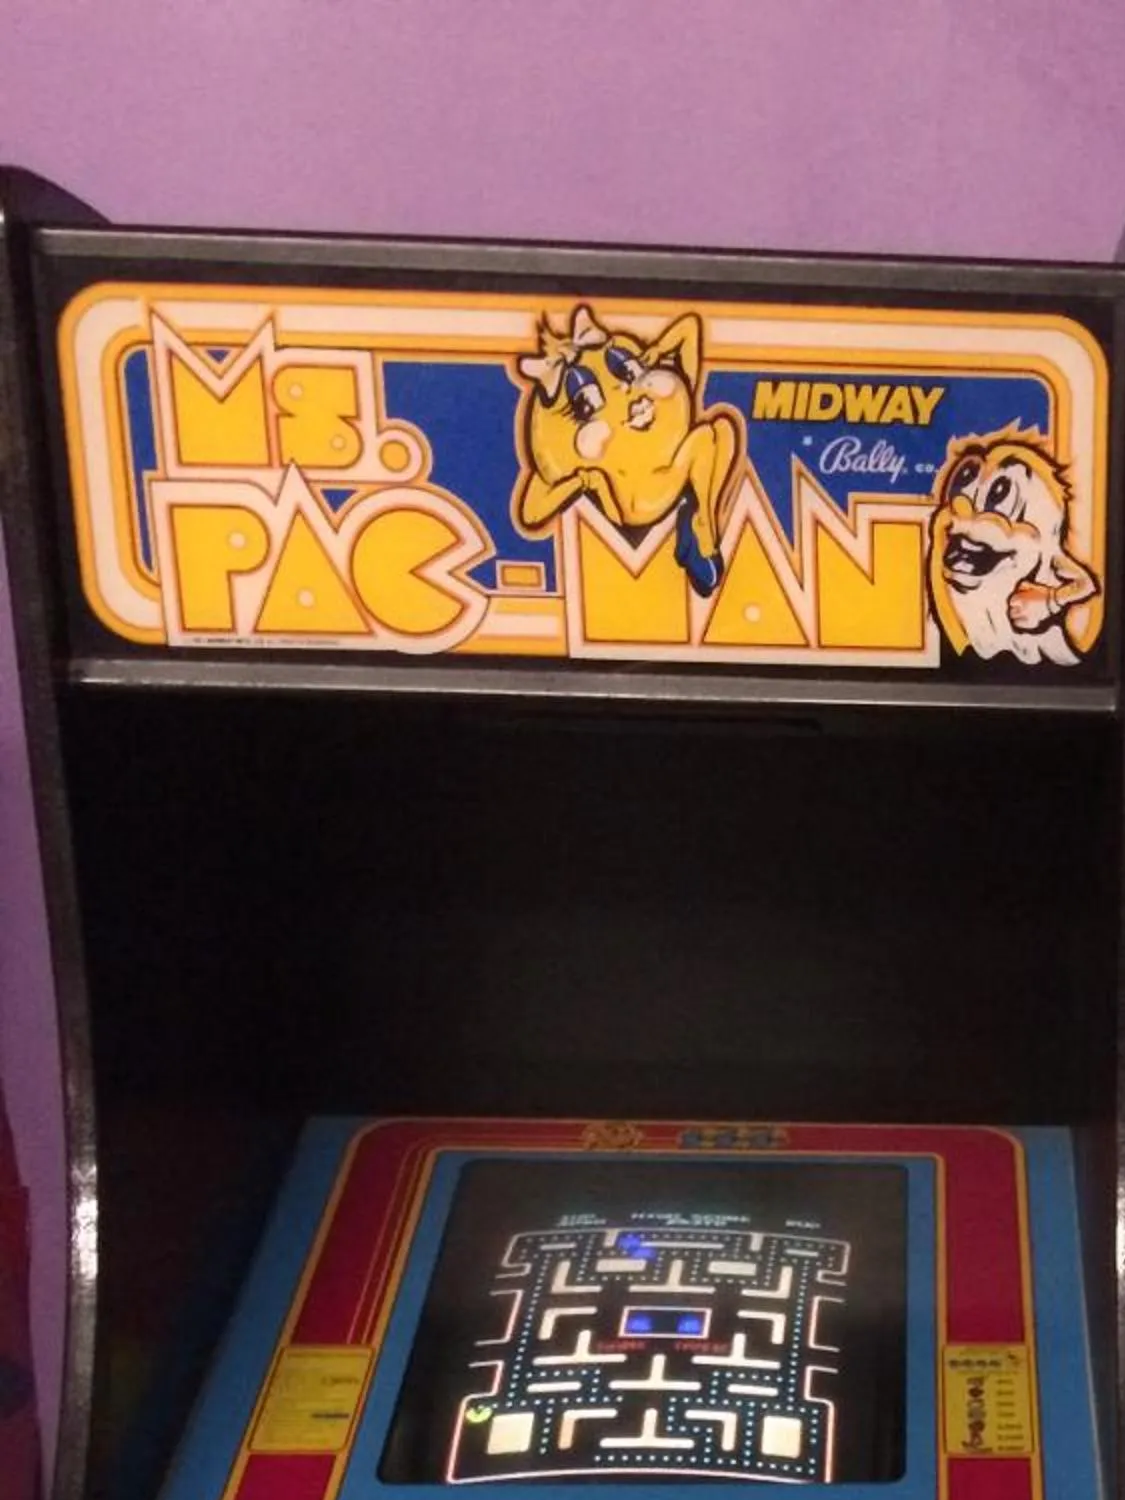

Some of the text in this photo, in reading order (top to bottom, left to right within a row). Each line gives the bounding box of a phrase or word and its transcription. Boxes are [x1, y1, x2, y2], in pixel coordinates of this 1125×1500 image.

[150, 307, 427, 482] MS.
[752, 380, 945, 425] MIDWAY
[150, 460, 940, 667] PAC-MAN
